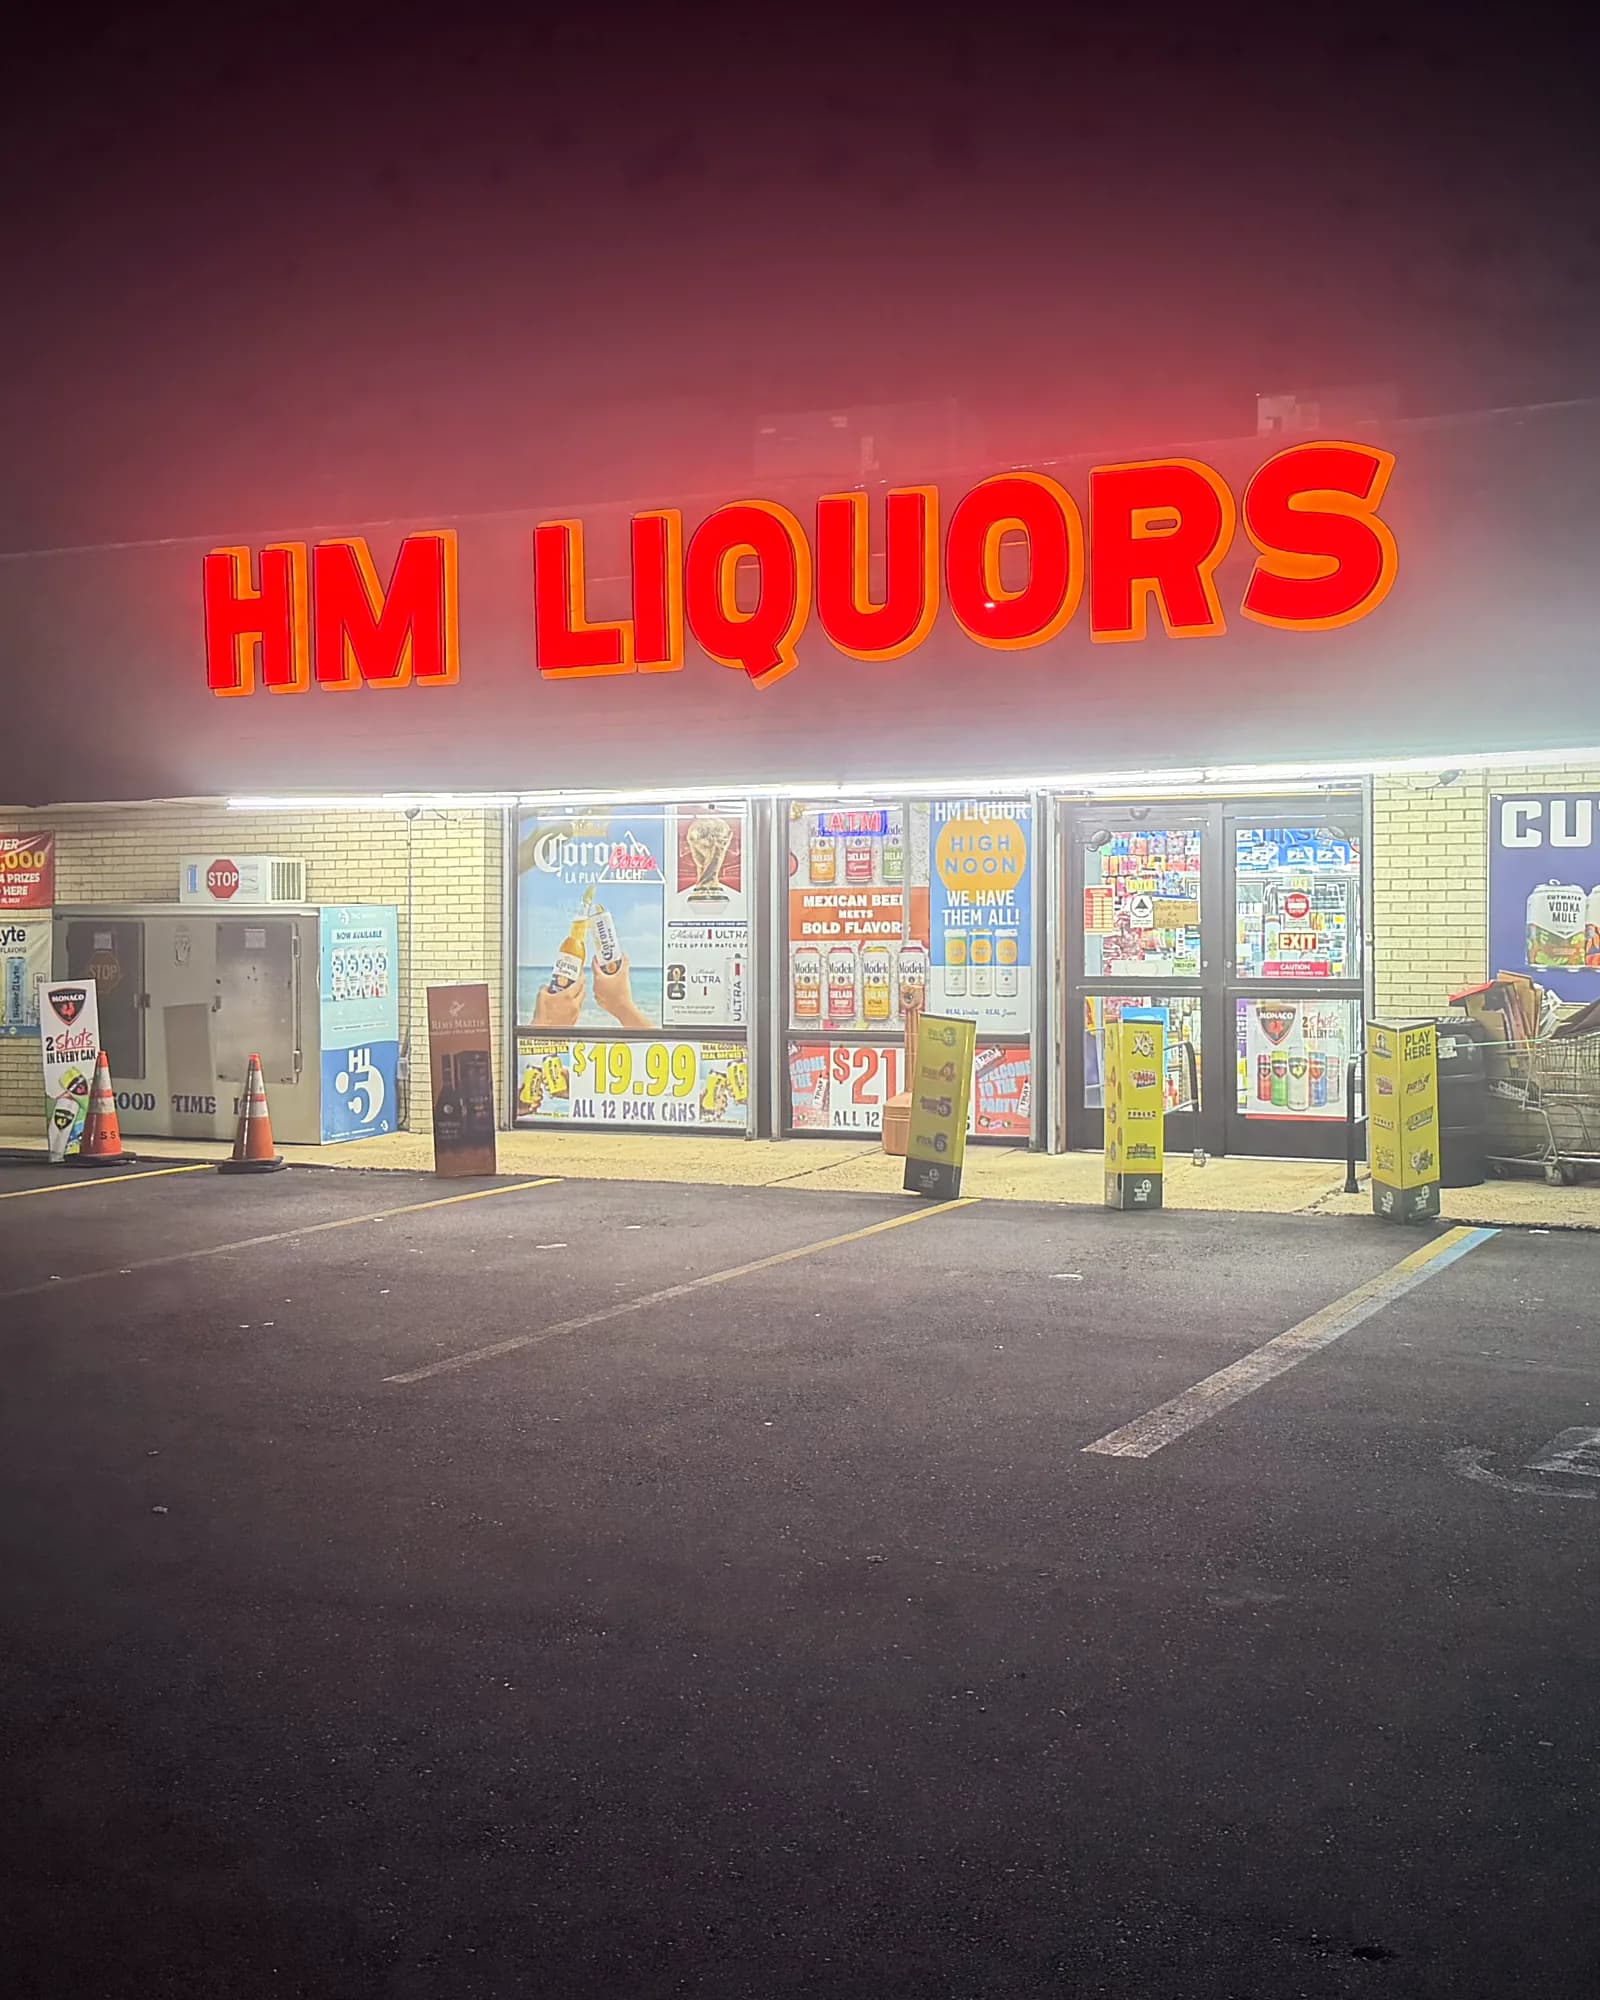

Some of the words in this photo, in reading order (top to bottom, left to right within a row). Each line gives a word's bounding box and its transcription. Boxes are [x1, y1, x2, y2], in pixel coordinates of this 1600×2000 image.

[203, 528, 460, 697] HM
[533, 440, 1399, 690] LIQUORS
[935, 801, 961, 821] HM
[829, 812, 881, 832] ATM
[1501, 799, 1600, 847] CU
[951, 835, 1011, 853] HIGH
[945, 858, 1016, 875] NOON
[7, 873, 41, 884] PRIZES
[208, 871, 238, 887] STOP
[3, 886, 29, 896] HERE
[947, 890, 969, 906] WE
[976, 890, 1015, 906] HAVE
[803, 895, 867, 907] MEXICAN
[1548, 901, 1580, 912] VODKA
[838, 909, 874, 918] MEETS
[942, 909, 981, 926] THEM
[988, 908, 1020, 925] ALL!
[1552, 912, 1577, 923] MULE
[336, 931, 351, 940] NOW
[802, 922, 841, 934] BOLD
[1280, 934, 1316, 949] EXIT
[88, 964, 118, 980] STOP
[1280, 963, 1311, 971] CAUTION
[51, 994, 85, 1002] MONACO
[733, 981, 742, 1022] ULTRA
[1258, 1012, 1293, 1020] MONACO
[46, 1037, 54, 1051] 2
[1406, 1030, 1430, 1047] PLAY
[56, 1051, 79, 1065] EVERY
[80, 1050, 96, 1062] CAN
[1405, 1043, 1431, 1061] HERE
[348, 1048, 371, 1073] HI
[573, 1041, 697, 1097] $19.99
[172, 1094, 217, 1115] TIME
[573, 1099, 595, 1118] ALL
[601, 1100, 616, 1119] 12
[623, 1100, 656, 1121] PACK
[661, 1102, 696, 1122] CANS
[833, 1110, 861, 1128] ALL
[865, 1111, 880, 1128] 12
